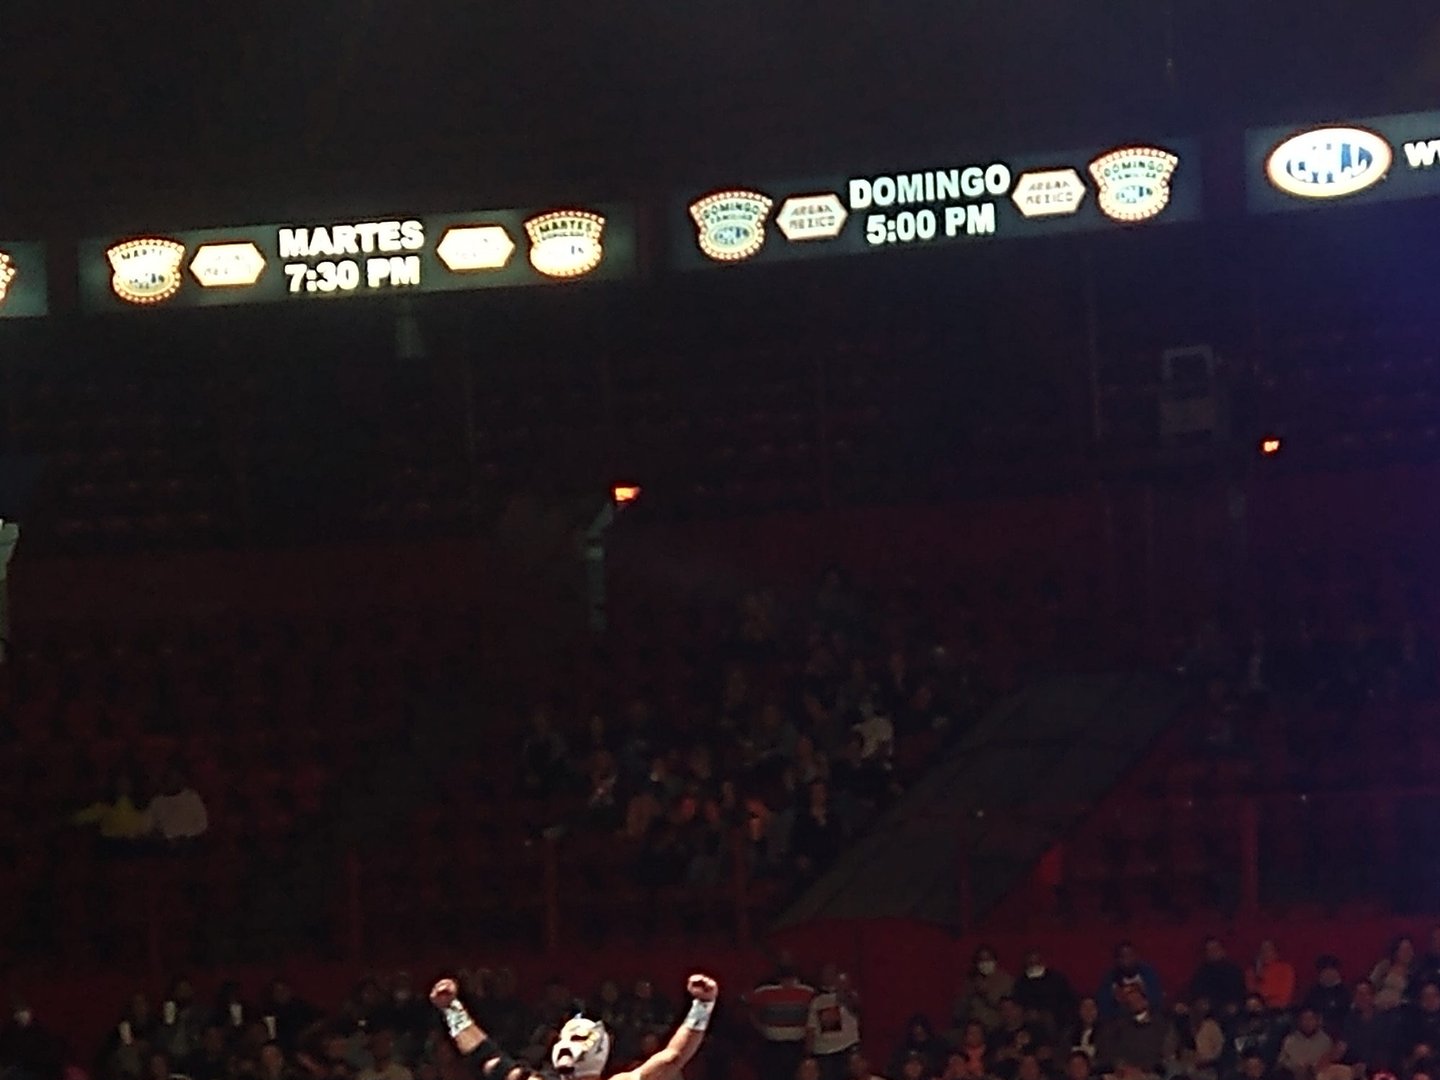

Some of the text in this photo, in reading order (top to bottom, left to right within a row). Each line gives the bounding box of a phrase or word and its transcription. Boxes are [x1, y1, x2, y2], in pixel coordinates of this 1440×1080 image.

[849, 163, 1012, 210] DOMINGO
[537, 220, 593, 234] MARTES
[703, 202, 761, 220] DOMINGO
[866, 201, 997, 246] 5:00 PM
[278, 220, 425, 258] MARTES
[284, 256, 421, 293] 7:30 PM
